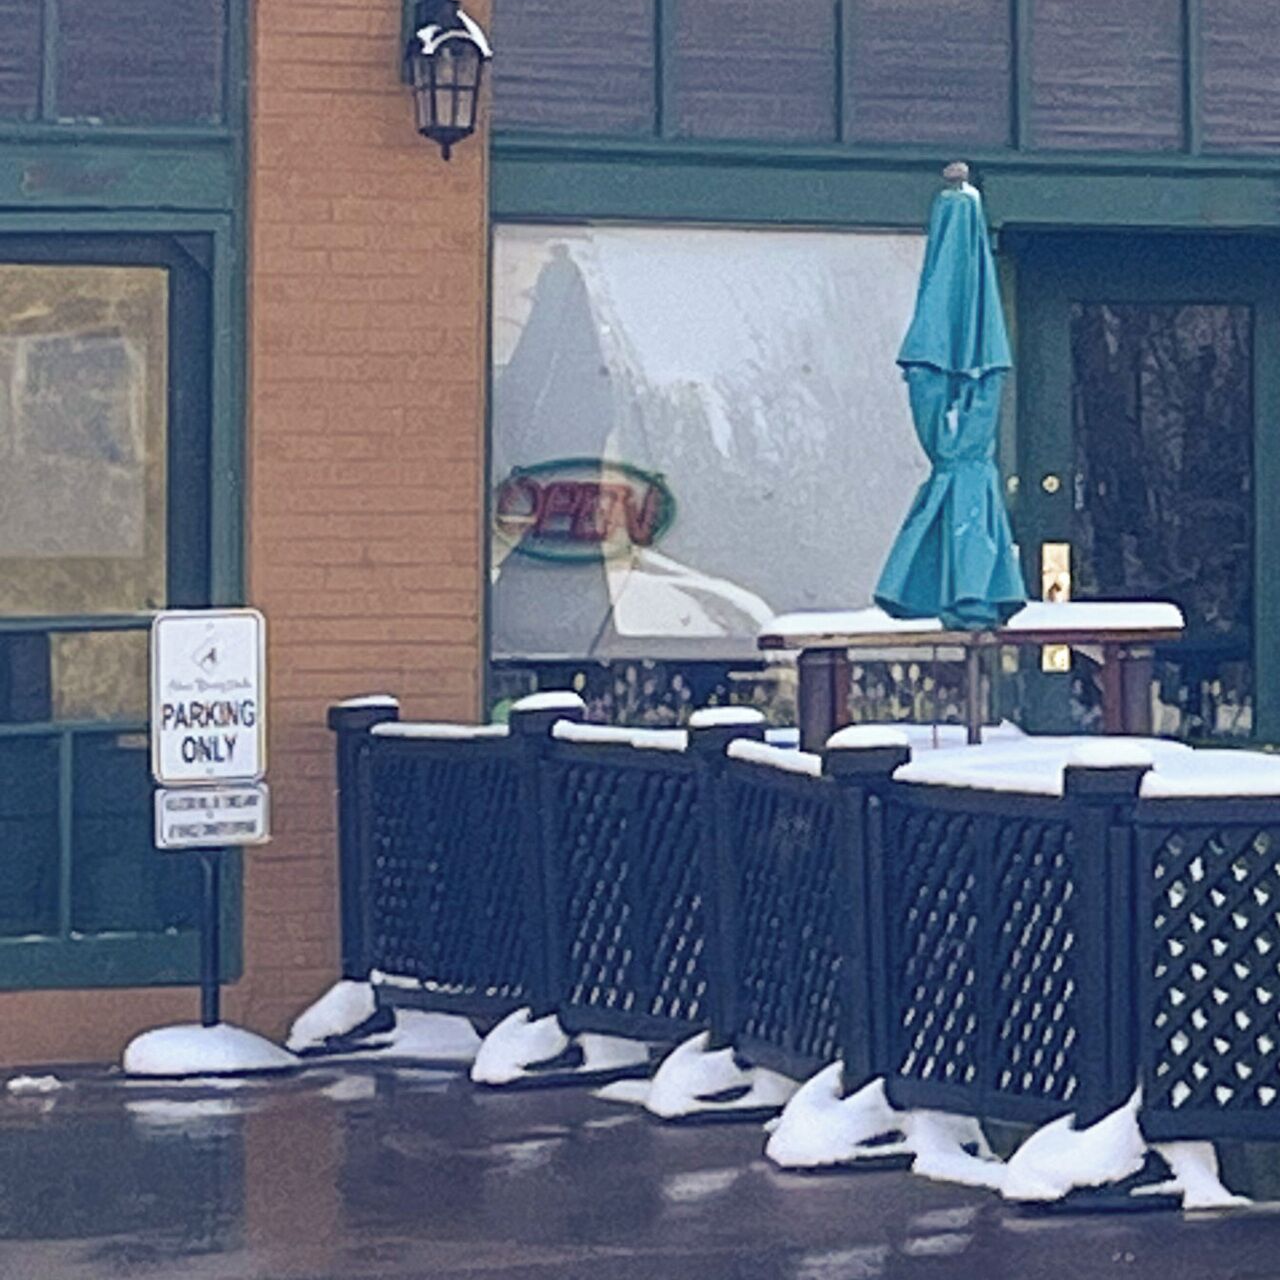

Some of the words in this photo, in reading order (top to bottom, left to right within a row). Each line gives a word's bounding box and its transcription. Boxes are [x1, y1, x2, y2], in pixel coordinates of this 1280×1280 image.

[497, 476, 662, 546] OPEN
[162, 700, 256, 730] PARKING
[181, 735, 237, 764] ONLY
